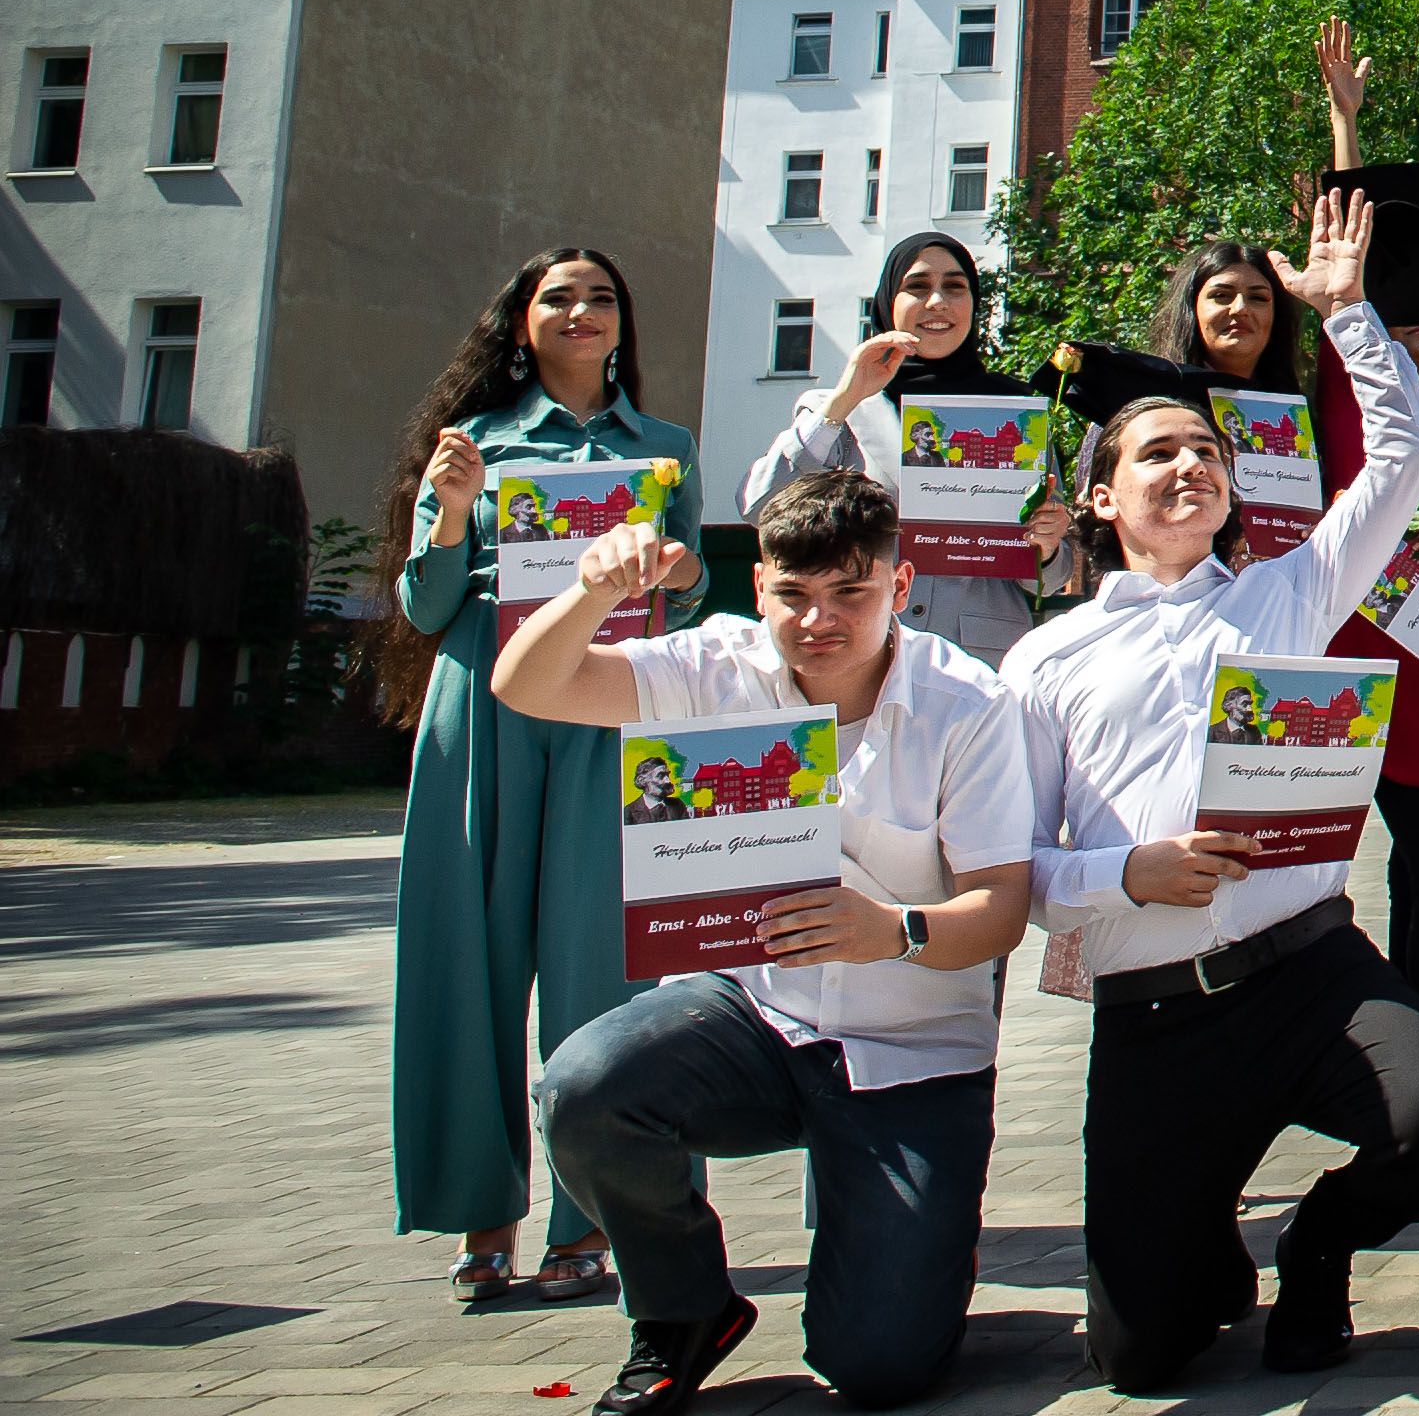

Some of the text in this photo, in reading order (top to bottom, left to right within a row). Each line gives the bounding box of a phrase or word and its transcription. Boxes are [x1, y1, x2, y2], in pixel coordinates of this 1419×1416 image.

[920, 483, 966, 495] Herzlichen
[914, 534, 939, 544] Ernst
[945, 535, 970, 545] Abbe
[521, 556, 575, 571] Herzlichen
[1228, 764, 1365, 781] Herzlichen Glückwunsch!
[1253, 829, 1281, 839] Abbe
[1290, 823, 1351, 839] Gymnasium
[652, 828, 818, 860] Herzlichen Glückwunsch!
[648, 919, 685, 934] Ernst
[695, 914, 732, 928] Abbe
[699, 940, 735, 950] Tradition
[736, 936, 750, 945] seit
